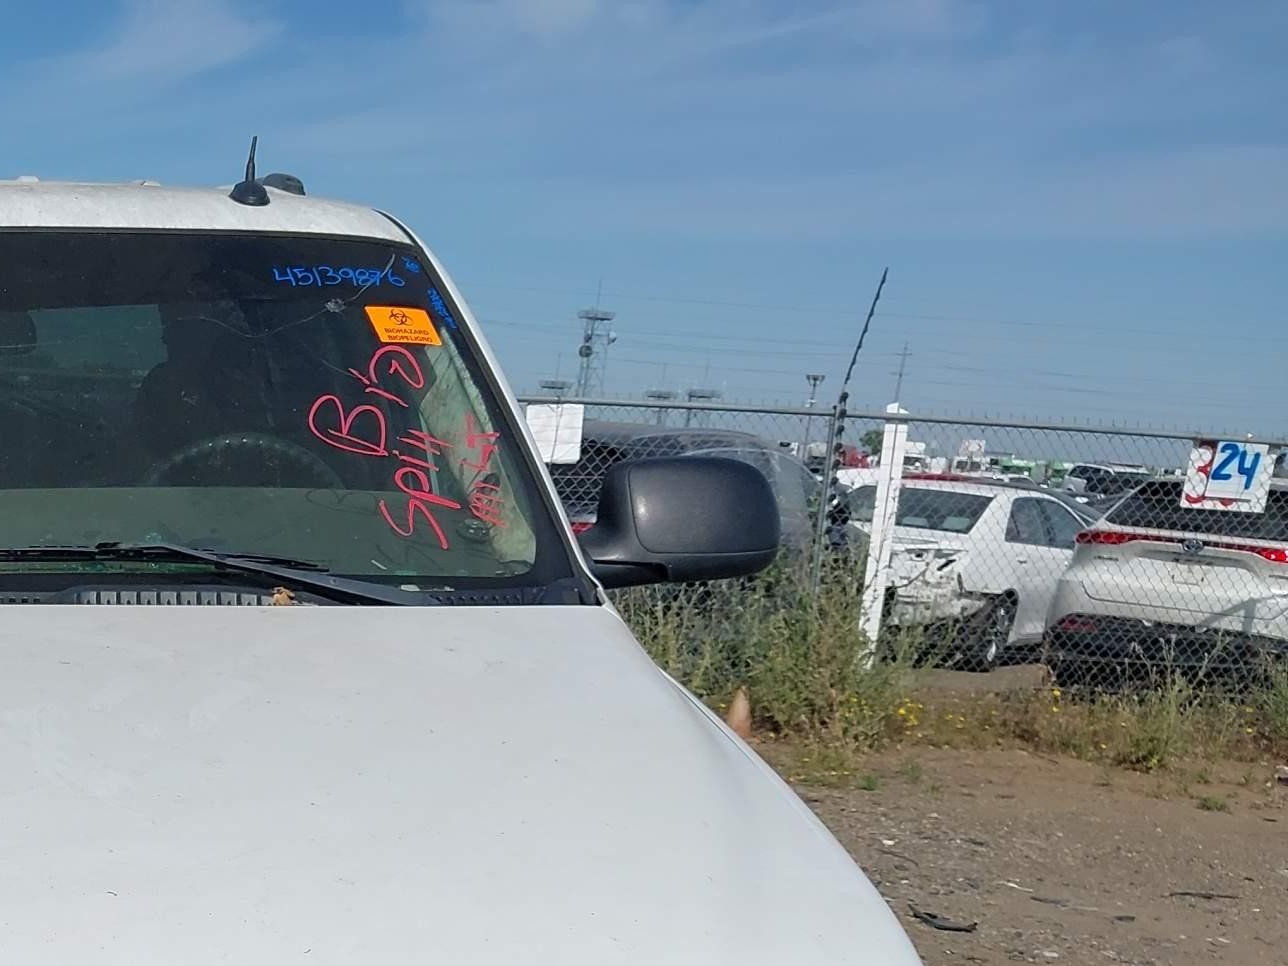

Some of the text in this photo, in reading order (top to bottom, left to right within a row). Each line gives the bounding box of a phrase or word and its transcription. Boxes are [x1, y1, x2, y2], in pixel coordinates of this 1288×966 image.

[273, 266, 405, 287] 45139876
[384, 327, 430, 336] BIOHAZARD
[388, 334, 433, 343] BIOPELIGRO
[1211, 443, 1261, 490] 24
